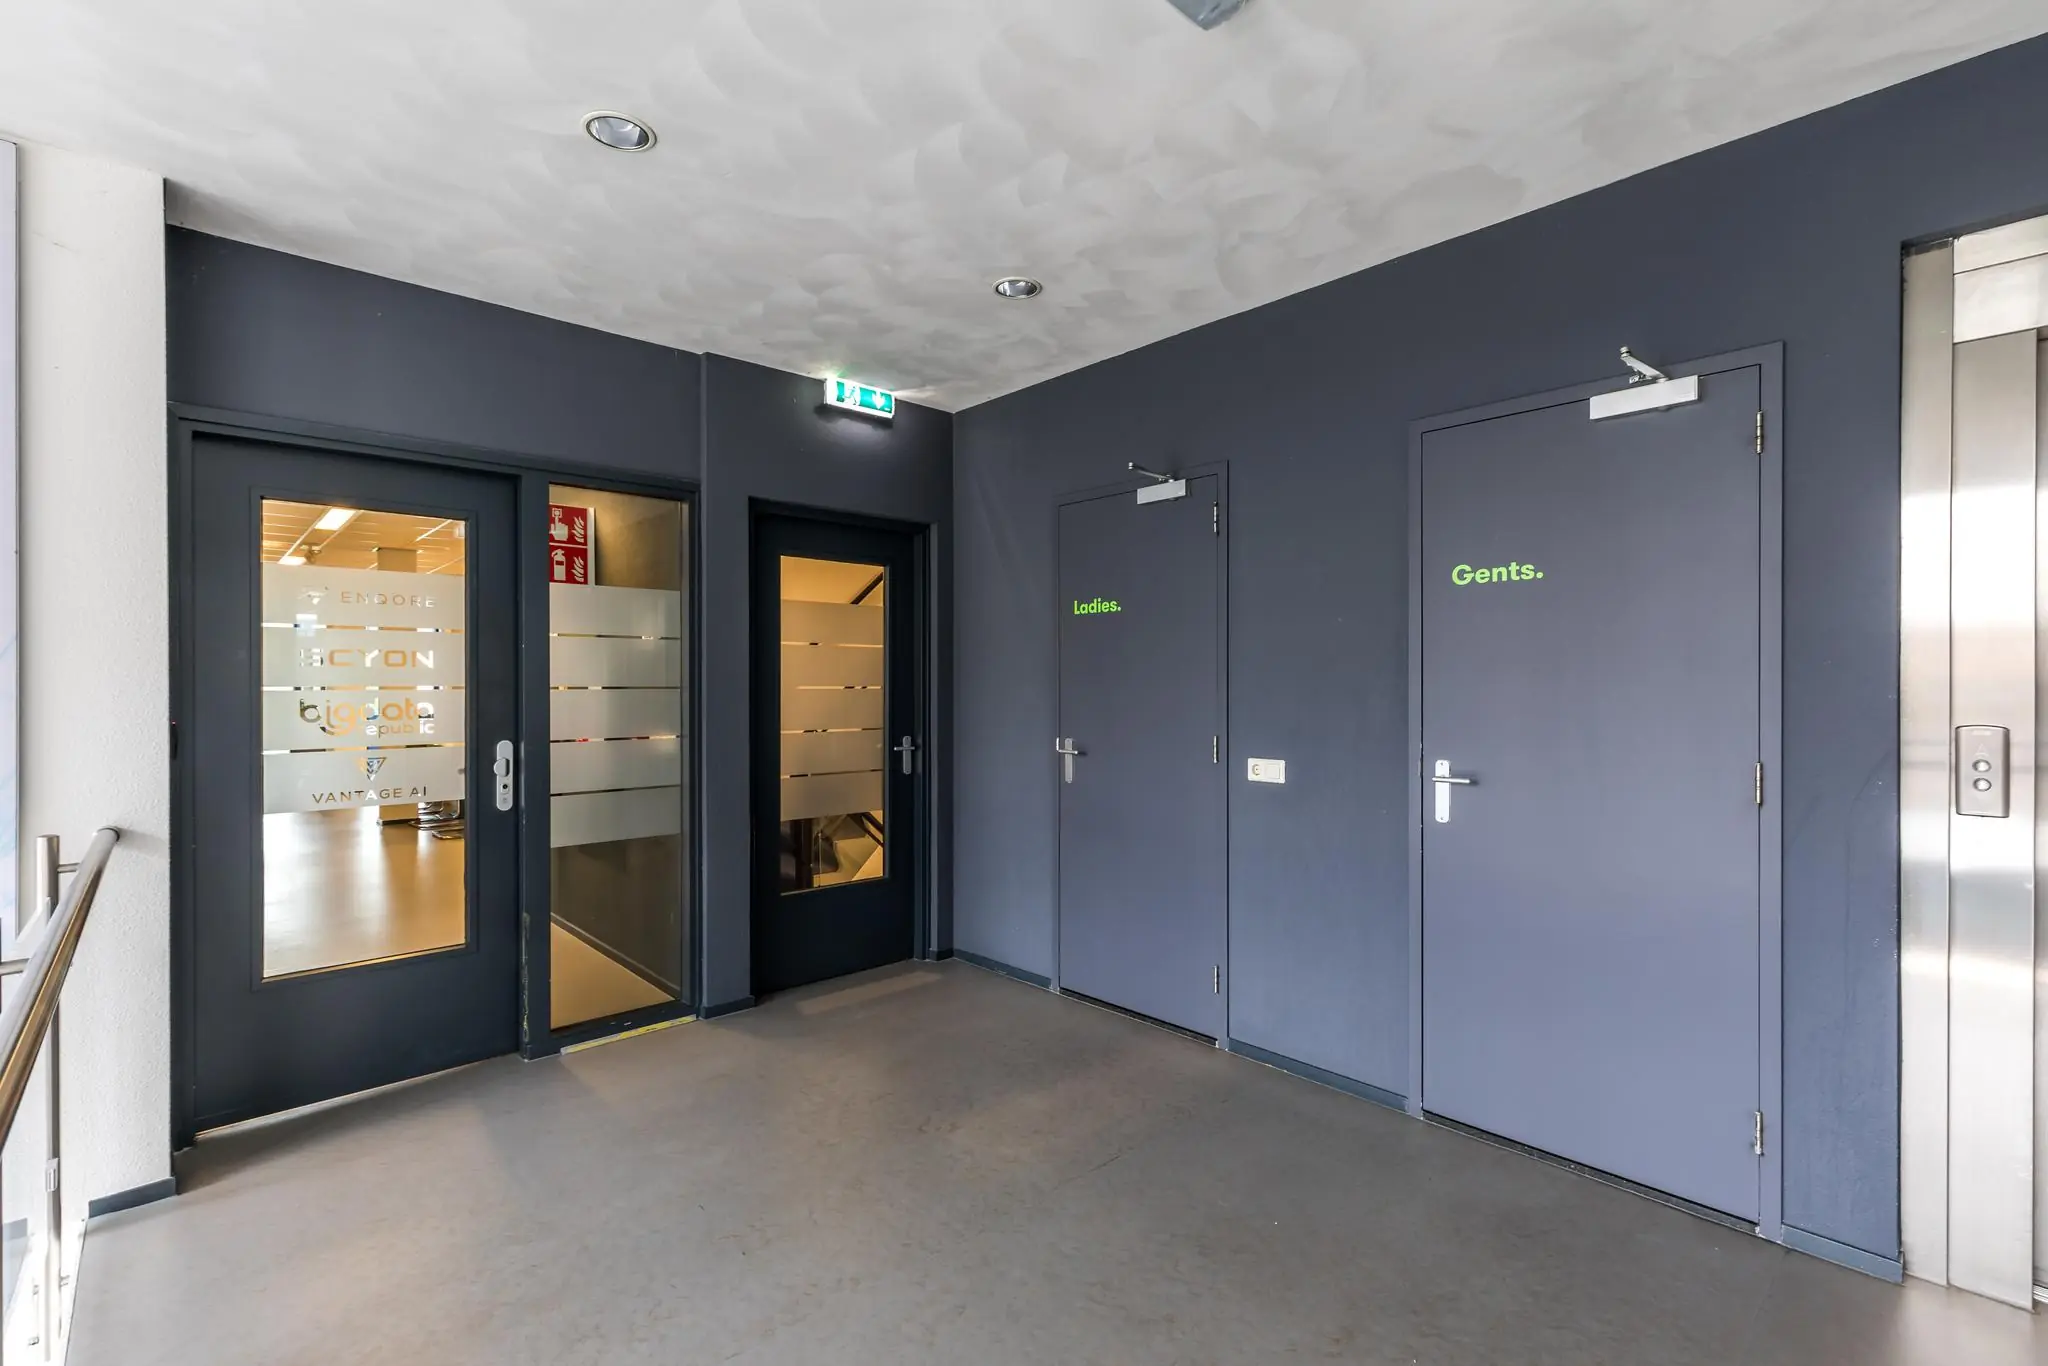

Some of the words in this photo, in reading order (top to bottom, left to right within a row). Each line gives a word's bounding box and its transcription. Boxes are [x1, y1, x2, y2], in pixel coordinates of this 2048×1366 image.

[1452, 562, 1544, 585] Gents.
[341, 591, 436, 608] ENQORE
[1073, 597, 1122, 615] Ladies.
[300, 648, 434, 669] SCYON
[312, 788, 403, 804] VANTAGE
[409, 786, 427, 798] AI
